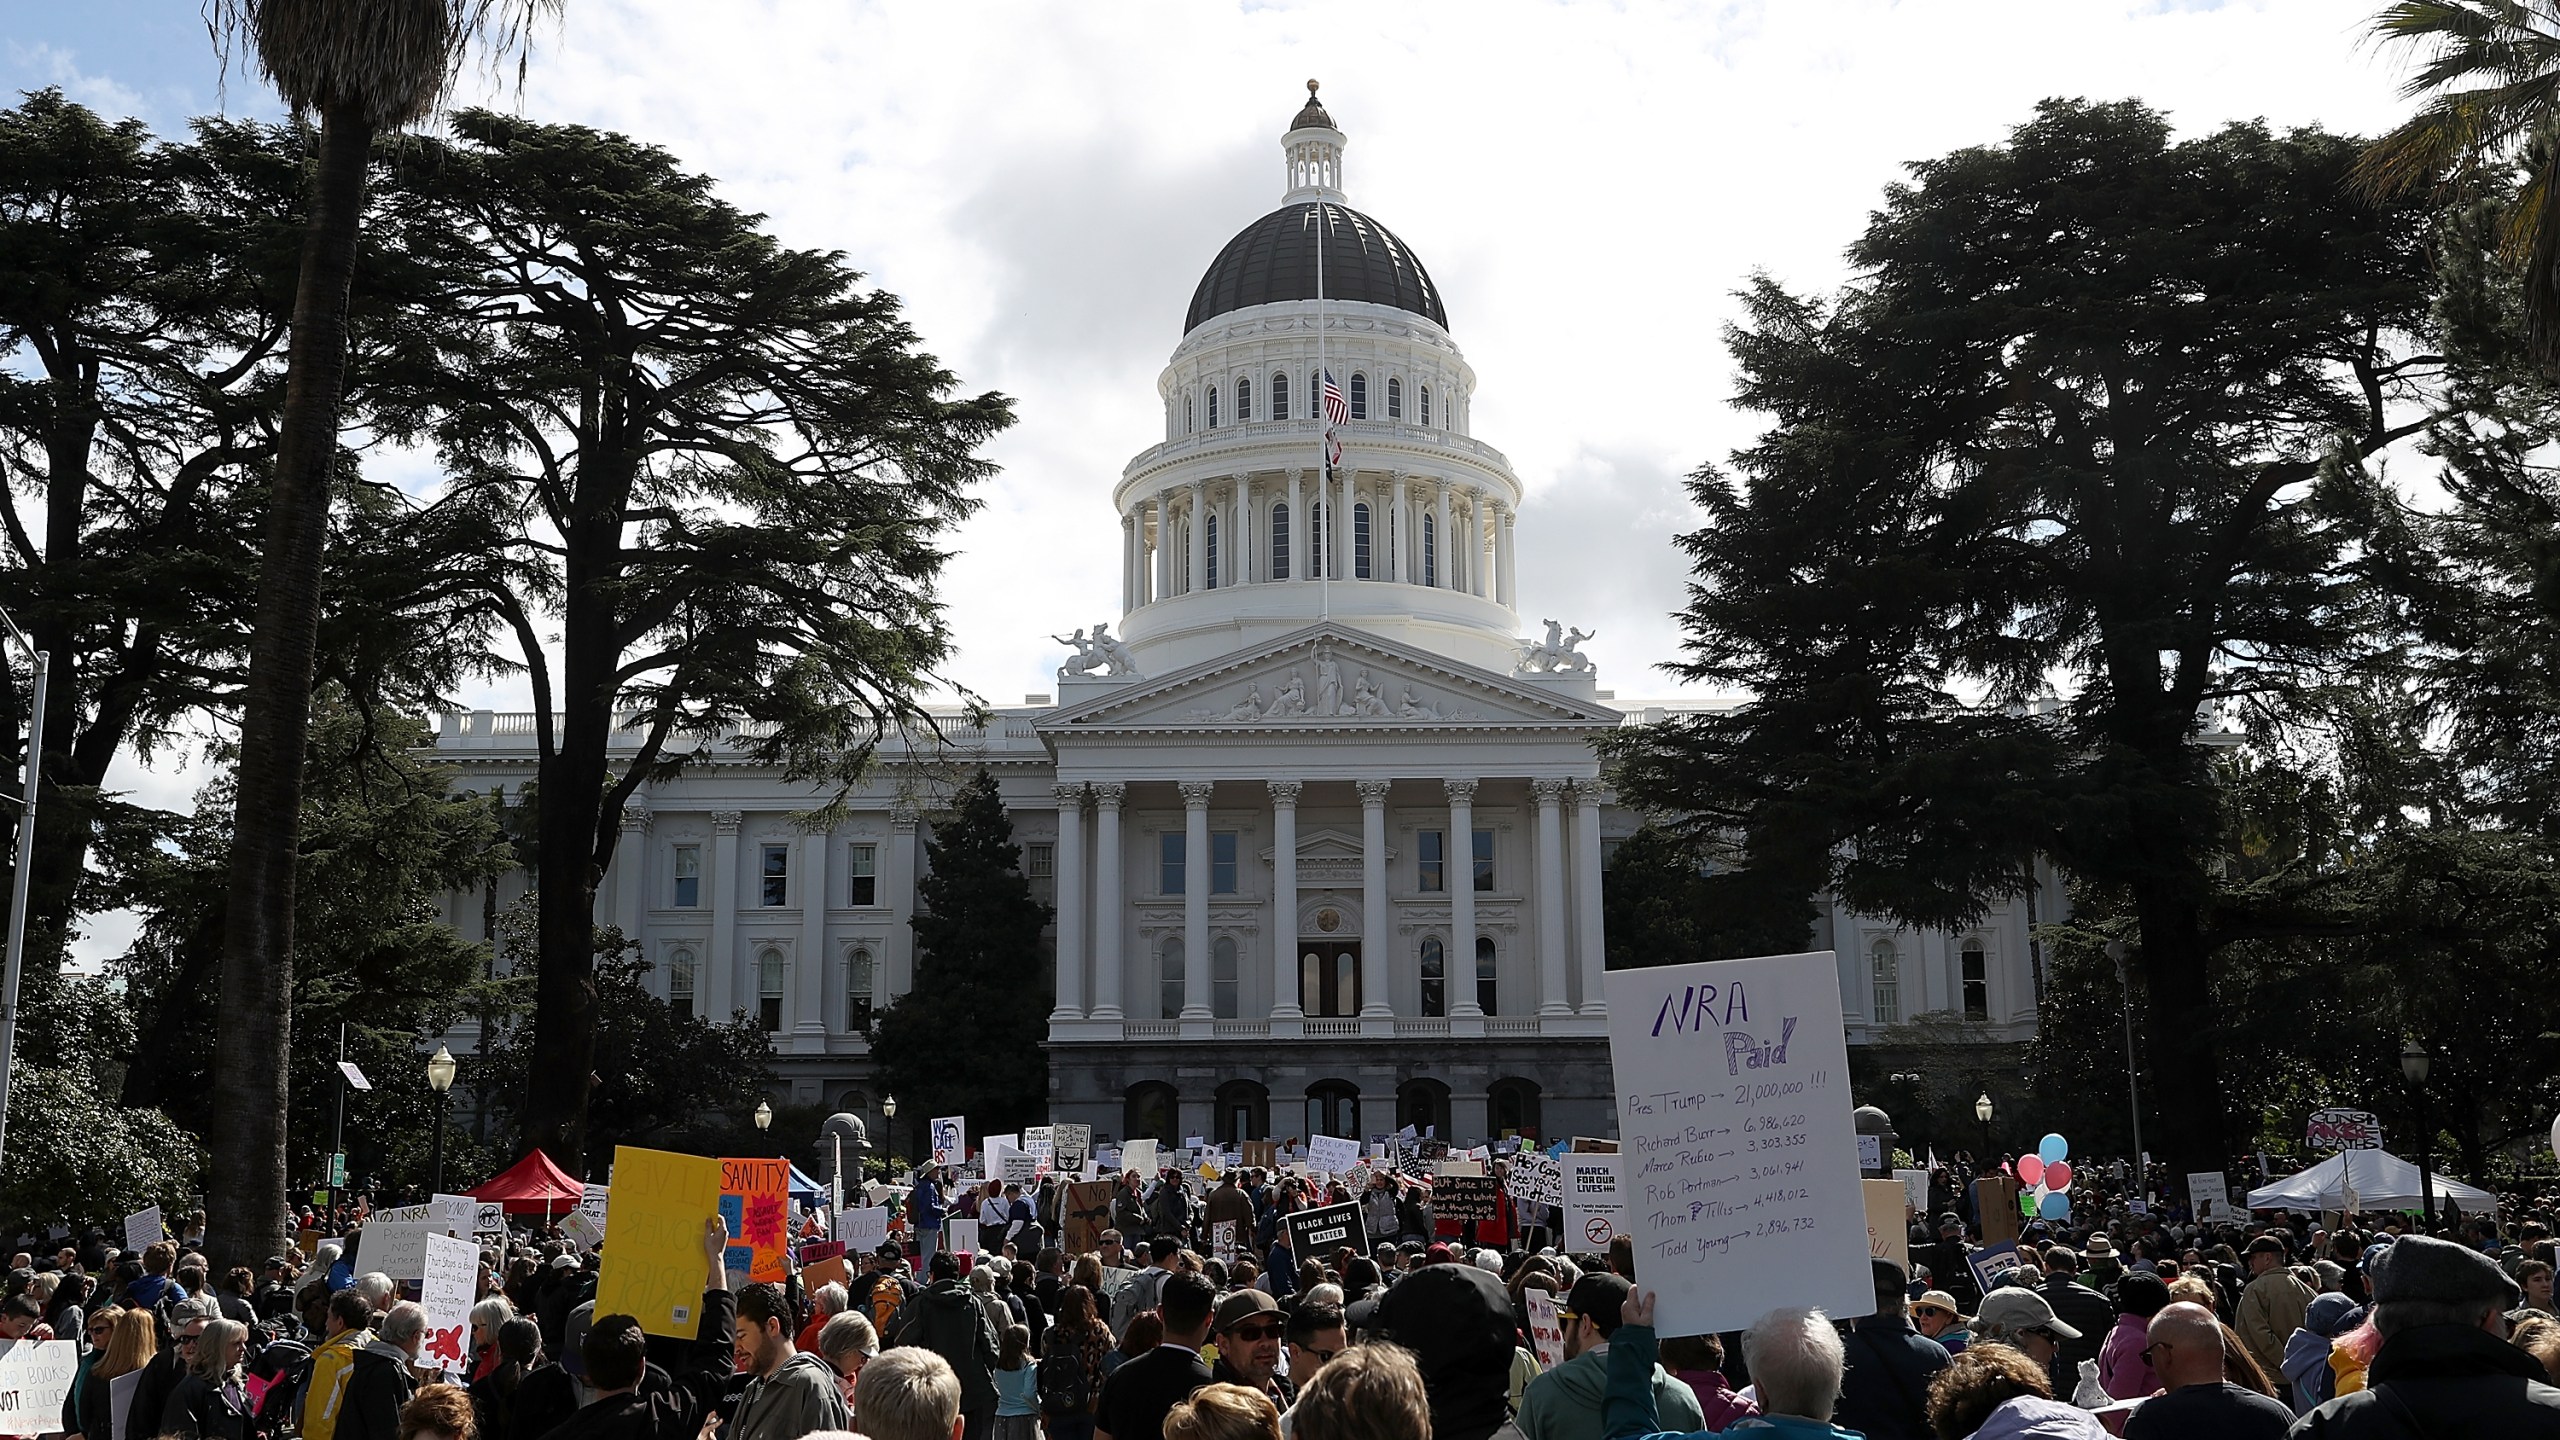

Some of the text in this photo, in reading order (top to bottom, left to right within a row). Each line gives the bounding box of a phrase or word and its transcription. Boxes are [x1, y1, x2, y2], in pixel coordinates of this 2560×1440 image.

[1651, 981, 1748, 1037] NRA
[1723, 1016, 1797, 1075] Paid
[1628, 1094, 1655, 1115] Pres.
[1650, 1091, 1706, 1113] Trump
[1734, 1083, 1804, 1107] 21,000,000
[932, 1119, 949, 1134] WE
[933, 1131, 954, 1150] CALL
[1312, 1137, 1332, 1148] SPEAK
[1633, 1133, 1681, 1155] Richard
[1684, 1126, 1716, 1144] Burr
[2308, 1136, 2380, 1150] DEATHS
[934, 1150, 946, 1164] BS
[1638, 1158, 1674, 1179] Marco
[1675, 1149, 1715, 1167] Rubio
[1309, 1163, 1328, 1171] VOICE
[1515, 1153, 1562, 1182] Hey Cong
[1576, 1166, 1610, 1176] MARCH
[720, 1161, 787, 1192] SANITY
[1512, 1169, 1531, 1185] See
[1534, 1176, 1551, 1187] you
[1576, 1175, 1616, 1184] FOR OUR
[1464, 1193, 1472, 1201] a
[1577, 1184, 1603, 1193] LIVES
[1645, 1184, 1676, 1204] Rob
[1677, 1176, 1722, 1195] Portman
[401, 1205, 430, 1223] NRA
[1297, 1212, 1352, 1231] BLACK LIVES
[1486, 1212, 1496, 1221] do
[1648, 1210, 1687, 1230] Thom
[1702, 1201, 1733, 1219] Tillis
[756, 1227, 772, 1238] BAN
[838, 1219, 883, 1240] ENOUGH
[1312, 1228, 1344, 1242] MATTER
[391, 1242, 419, 1252] NOT
[428, 1236, 441, 1250] The
[452, 1242, 469, 1260] Thing
[1652, 1239, 1688, 1259] Todd
[1692, 1236, 1731, 1263] Young
[381, 1254, 425, 1266] Funeral
[427, 1253, 441, 1267] That
[427, 1267, 439, 1285] Guy
[45, 1344, 62, 1362] TO
[26, 1365, 71, 1386] BOOKS
[25, 1388, 67, 1410] EULOG
